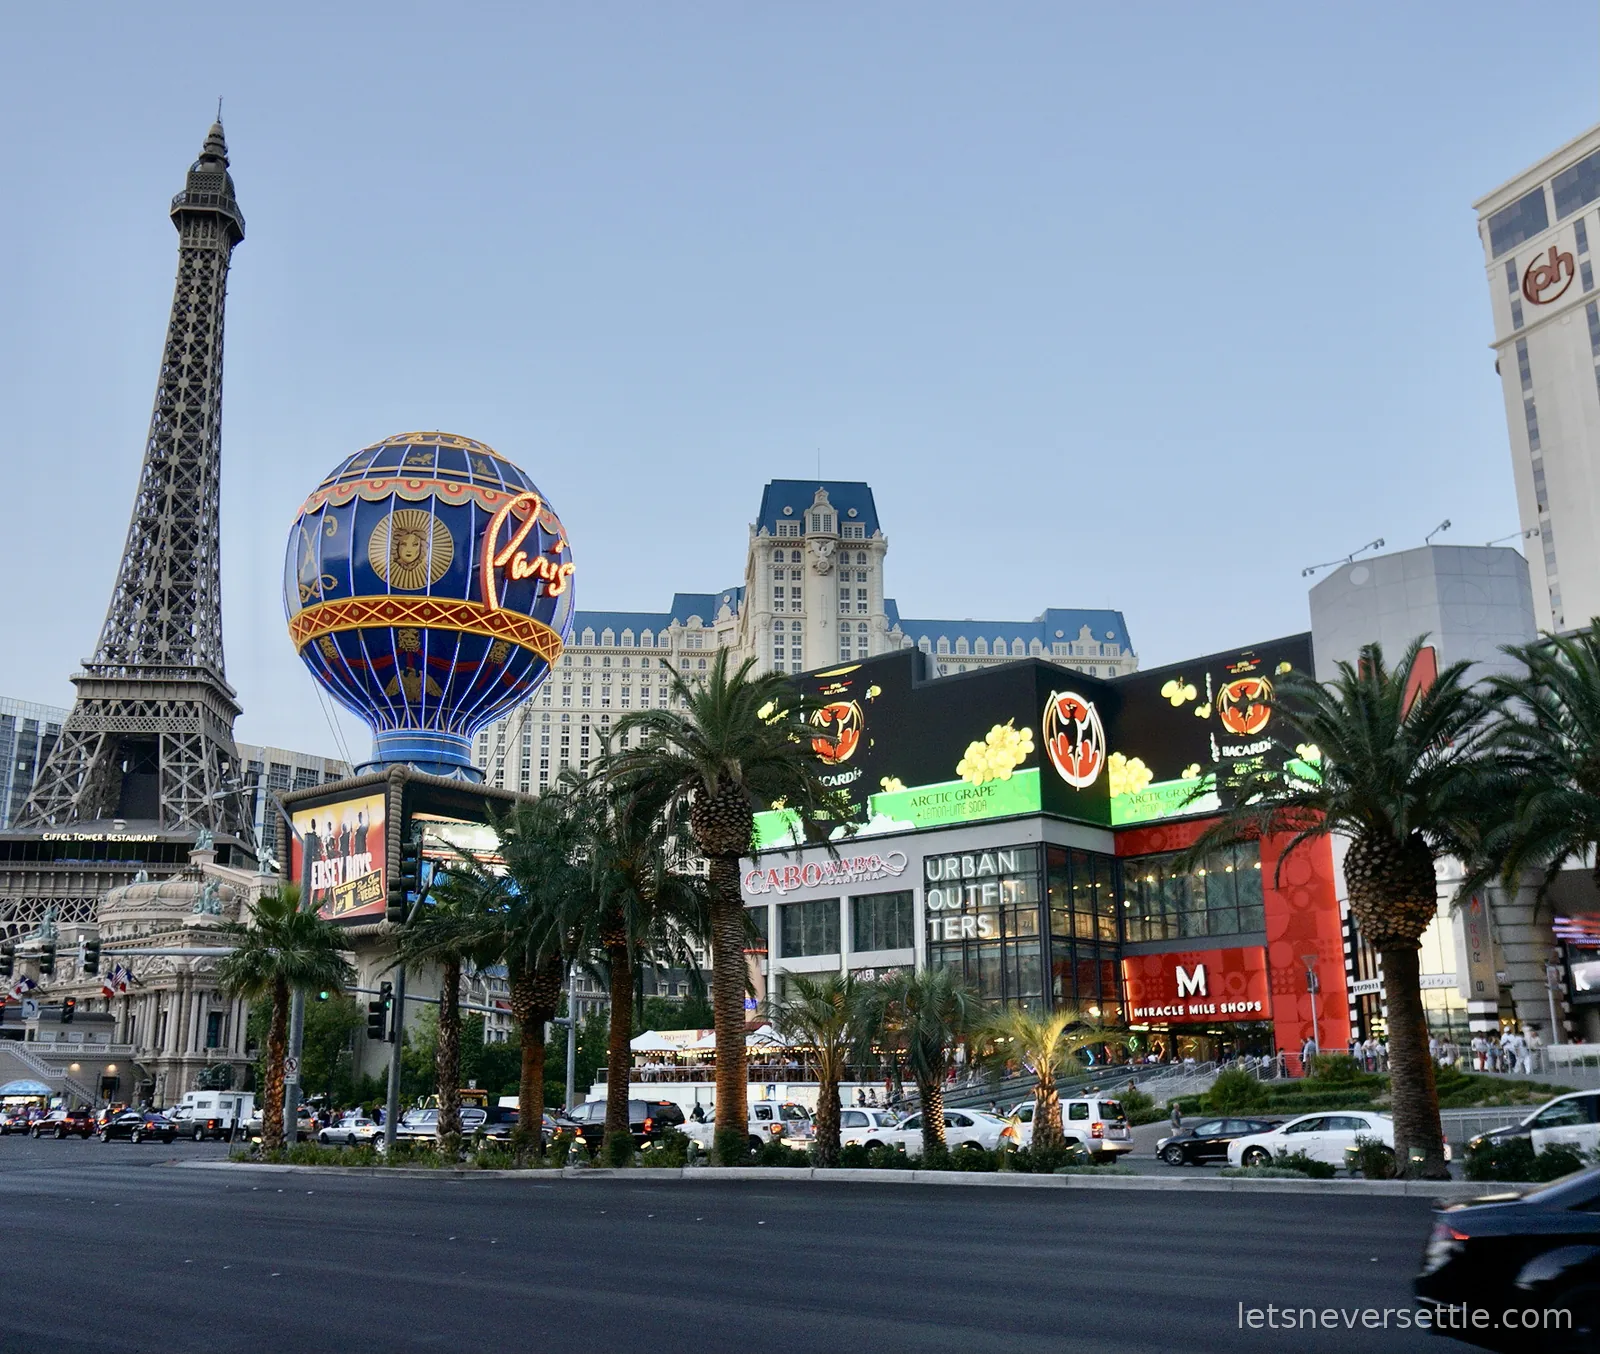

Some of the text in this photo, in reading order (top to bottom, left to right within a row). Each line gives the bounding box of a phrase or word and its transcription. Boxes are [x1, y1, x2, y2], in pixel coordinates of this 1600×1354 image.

[482, 490, 576, 611] Paris
[910, 785, 996, 808] ARCTIC GRAPE
[1166, 785, 1197, 799] GRAP
[968, 799, 988, 813] SODA
[73, 832, 103, 842] TOWER
[106, 833, 158, 843] RESTAURANT
[311, 859, 344, 890] ERSEY
[744, 853, 892, 896] CABO WABO
[926, 850, 1016, 881] URBAN
[335, 882, 357, 895] RATED
[825, 873, 882, 886] CANTINA
[360, 883, 381, 902] VEGAS
[927, 880, 1020, 911] OUTFIT
[928, 914, 993, 941] TERS
[1175, 963, 1207, 998] M
[1133, 1000, 1262, 1018] MIRACLE MILE SHOPS
